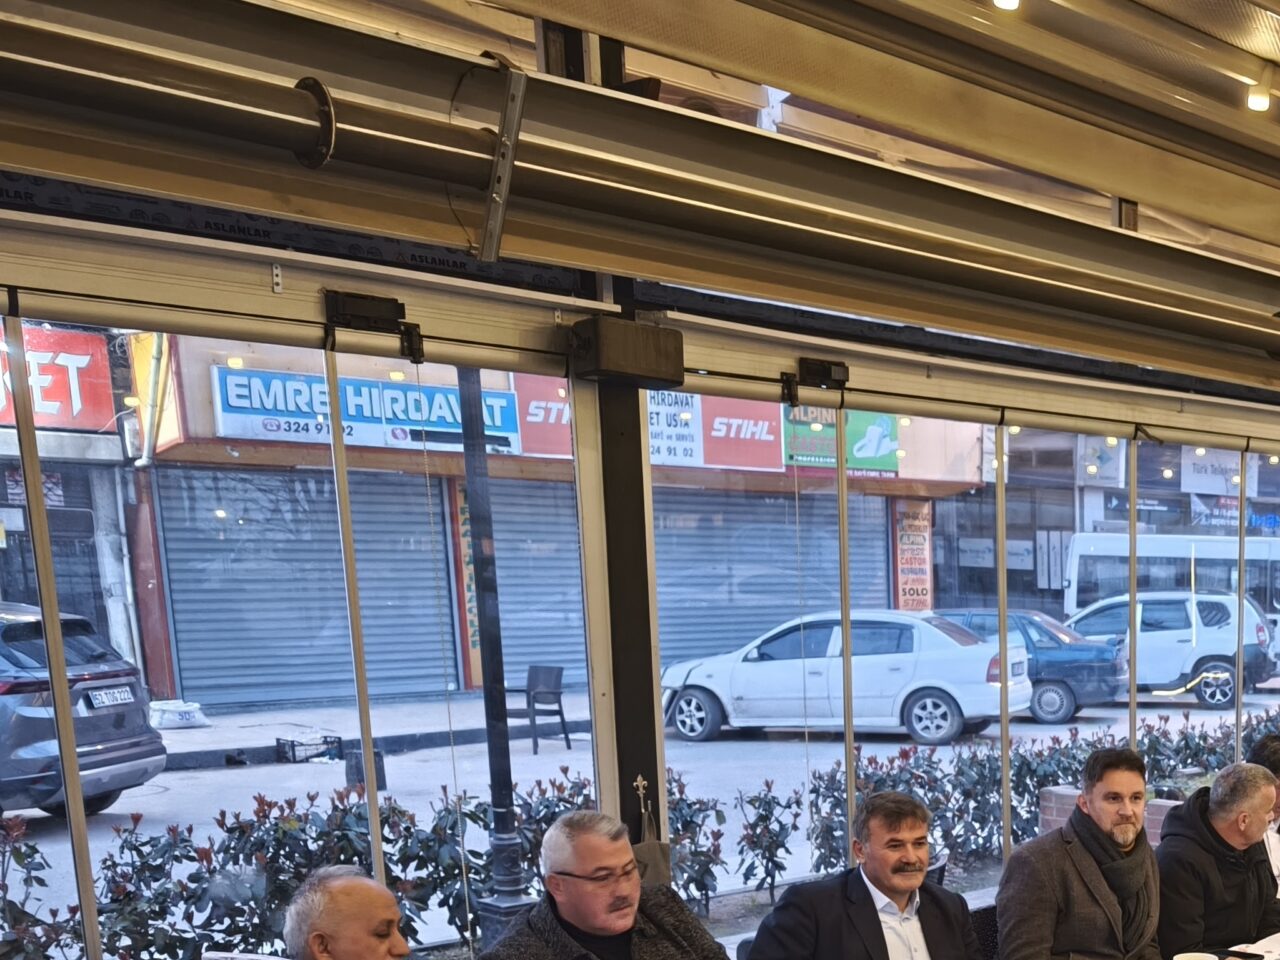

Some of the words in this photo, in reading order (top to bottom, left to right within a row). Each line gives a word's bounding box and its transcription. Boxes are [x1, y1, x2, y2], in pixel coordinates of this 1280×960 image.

[204, 220, 271, 240] ASLANLAR
[410, 254, 467, 269] ASLANLAR
[226, 375, 331, 414] EMRE
[284, 421, 310, 434] 324
[711, 416, 775, 441] STIHL
[902, 587, 929, 597] SOLO
